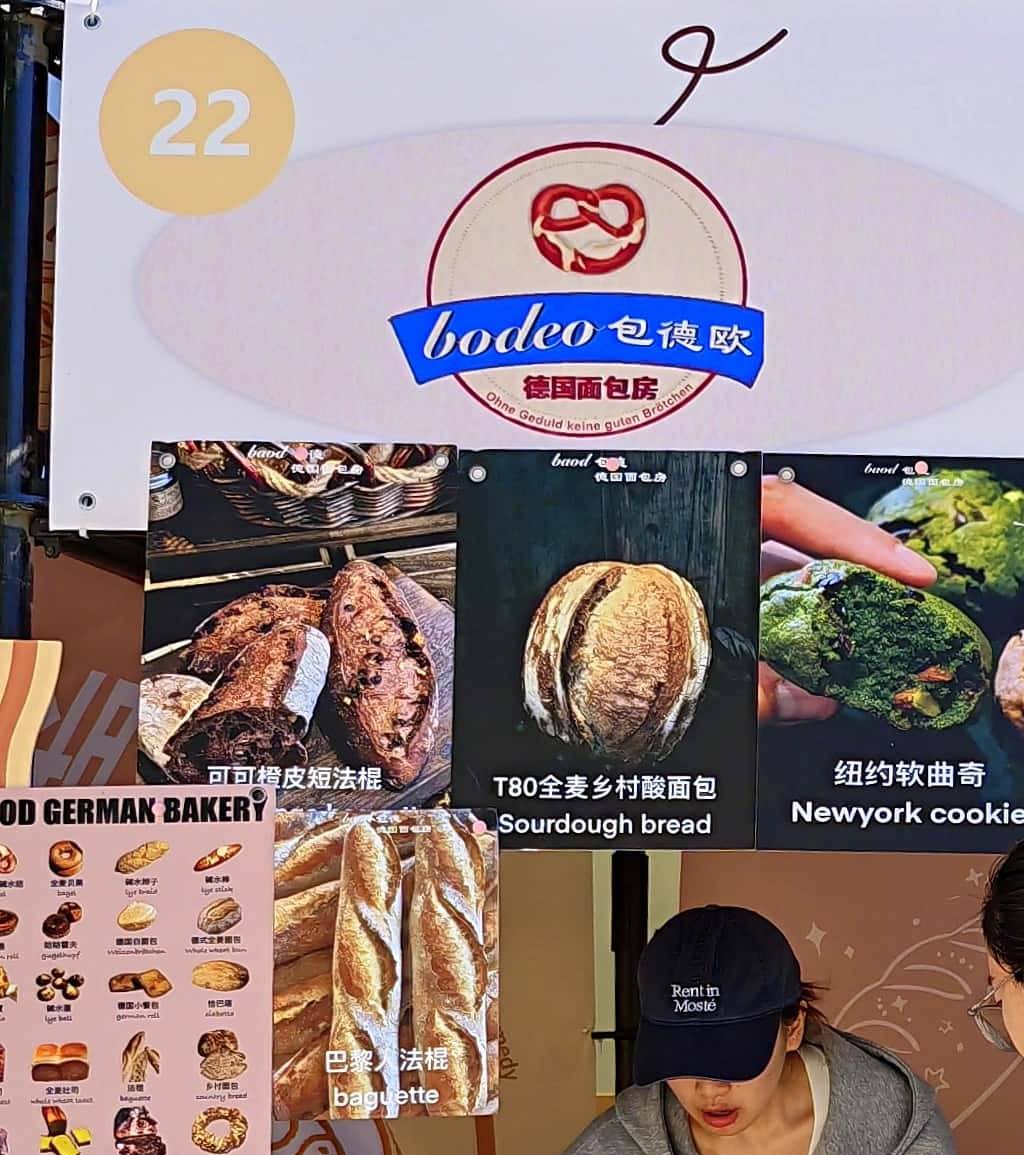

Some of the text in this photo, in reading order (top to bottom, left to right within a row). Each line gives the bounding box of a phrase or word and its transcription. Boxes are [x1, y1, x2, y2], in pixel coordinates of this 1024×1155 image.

[149, 88, 251, 156] 22
[422, 302, 753, 360] bodeo 包德欧
[522, 375, 659, 401] 德国面包房
[485, 382, 694, 432] Ohne Geduld keine guten Brötchen
[207, 765, 382, 791] 可可橙皮短法棍
[492, 774, 717, 801] T80全麦乡村酸面包
[833, 759, 987, 789] 纽约软曲奇
[43, 797, 156, 825] GERMAN
[163, 794, 268, 824] BAKERY
[791, 800, 922, 831] Newyork
[498, 813, 712, 839] Sourdough bread
[670, 984, 721, 998] Rent in
[324, 1047, 449, 1074] 巴黎人法棍
[333, 1086, 440, 1110] baguette
